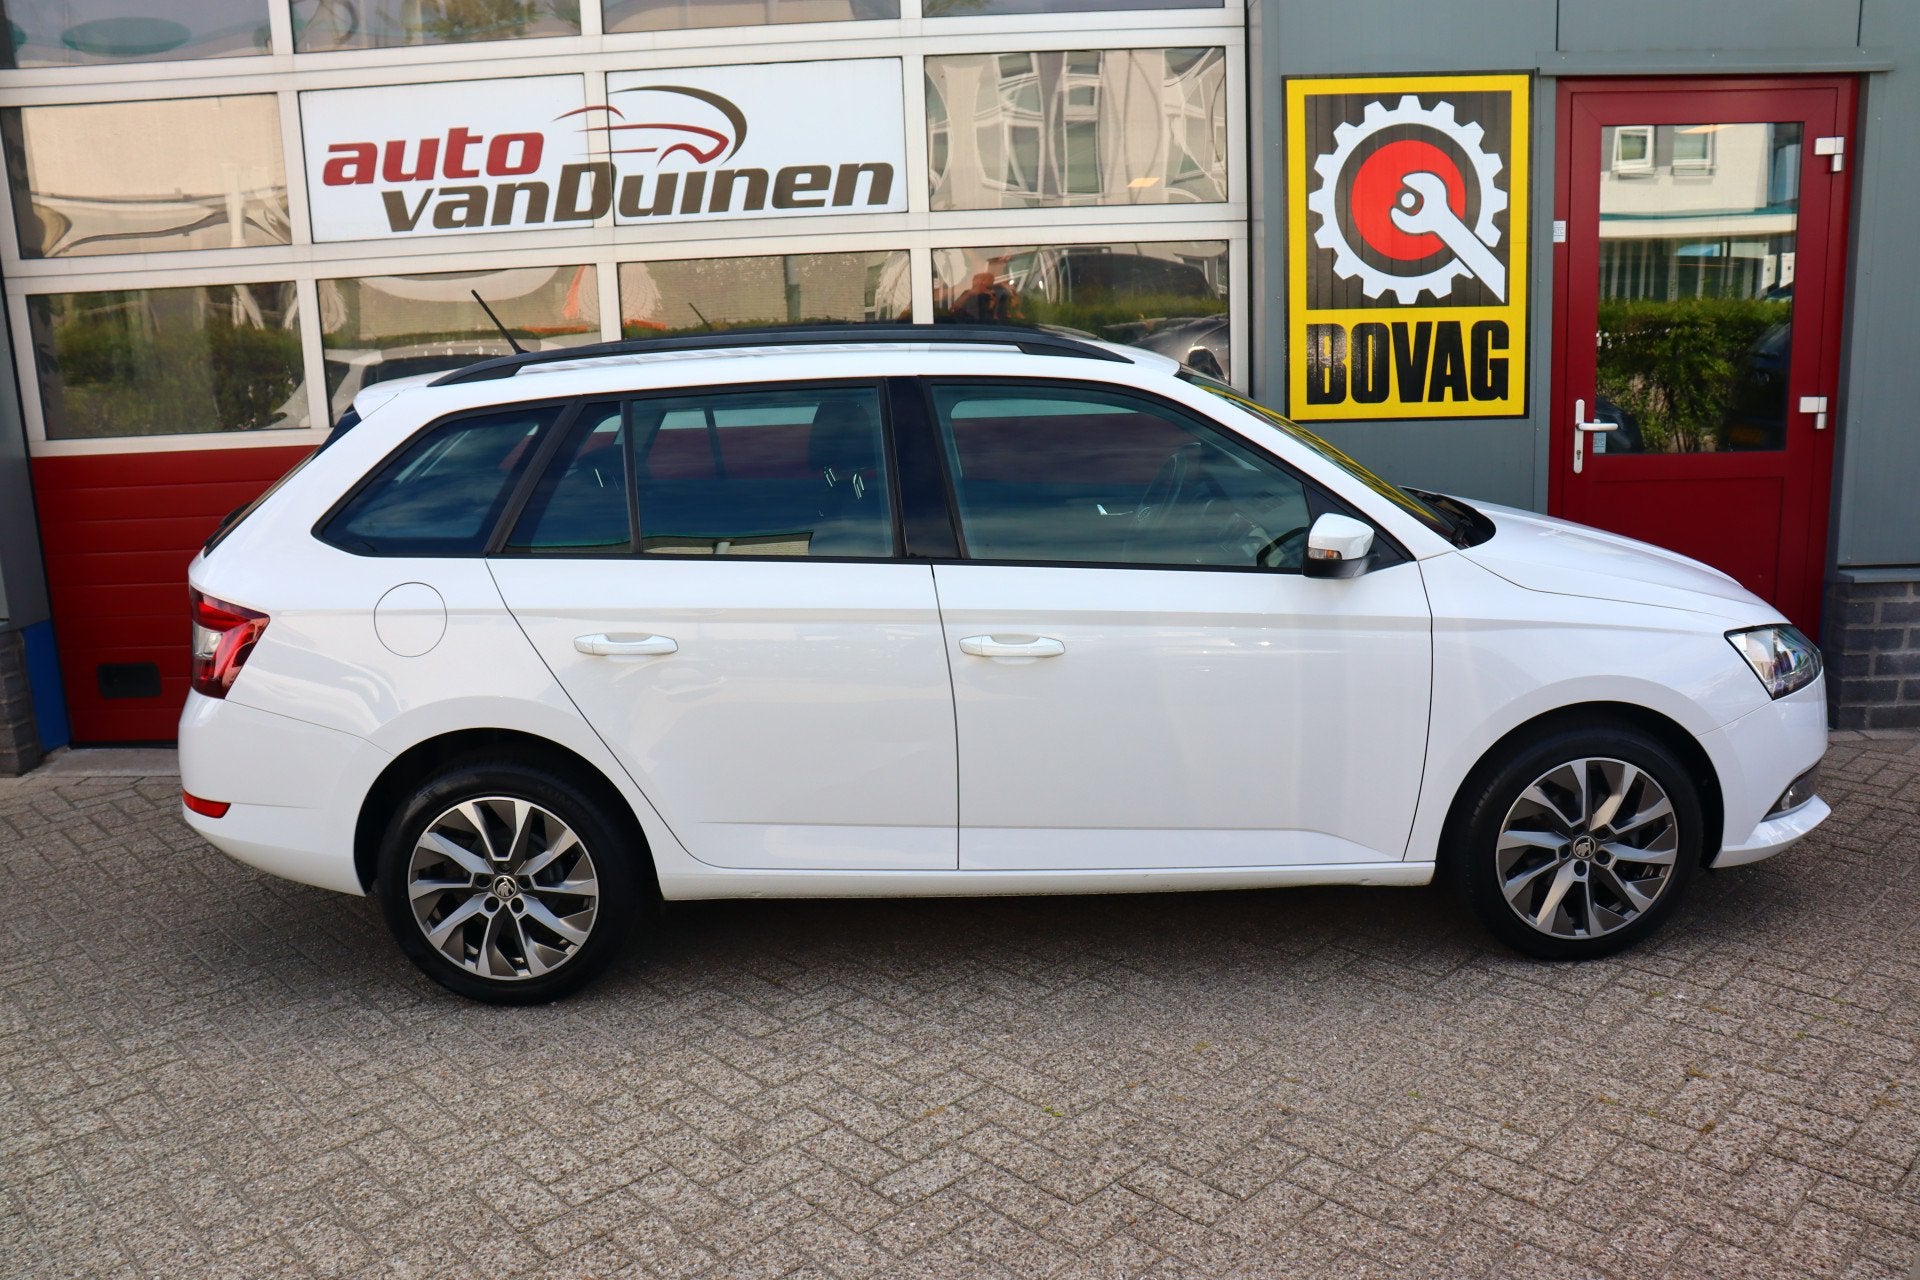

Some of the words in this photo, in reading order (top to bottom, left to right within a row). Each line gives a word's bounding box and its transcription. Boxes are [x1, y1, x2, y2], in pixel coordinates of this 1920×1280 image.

[323, 127, 544, 186] auto
[381, 161, 894, 232] vanDuinen
[1306, 320, 1509, 405] BOVAG
